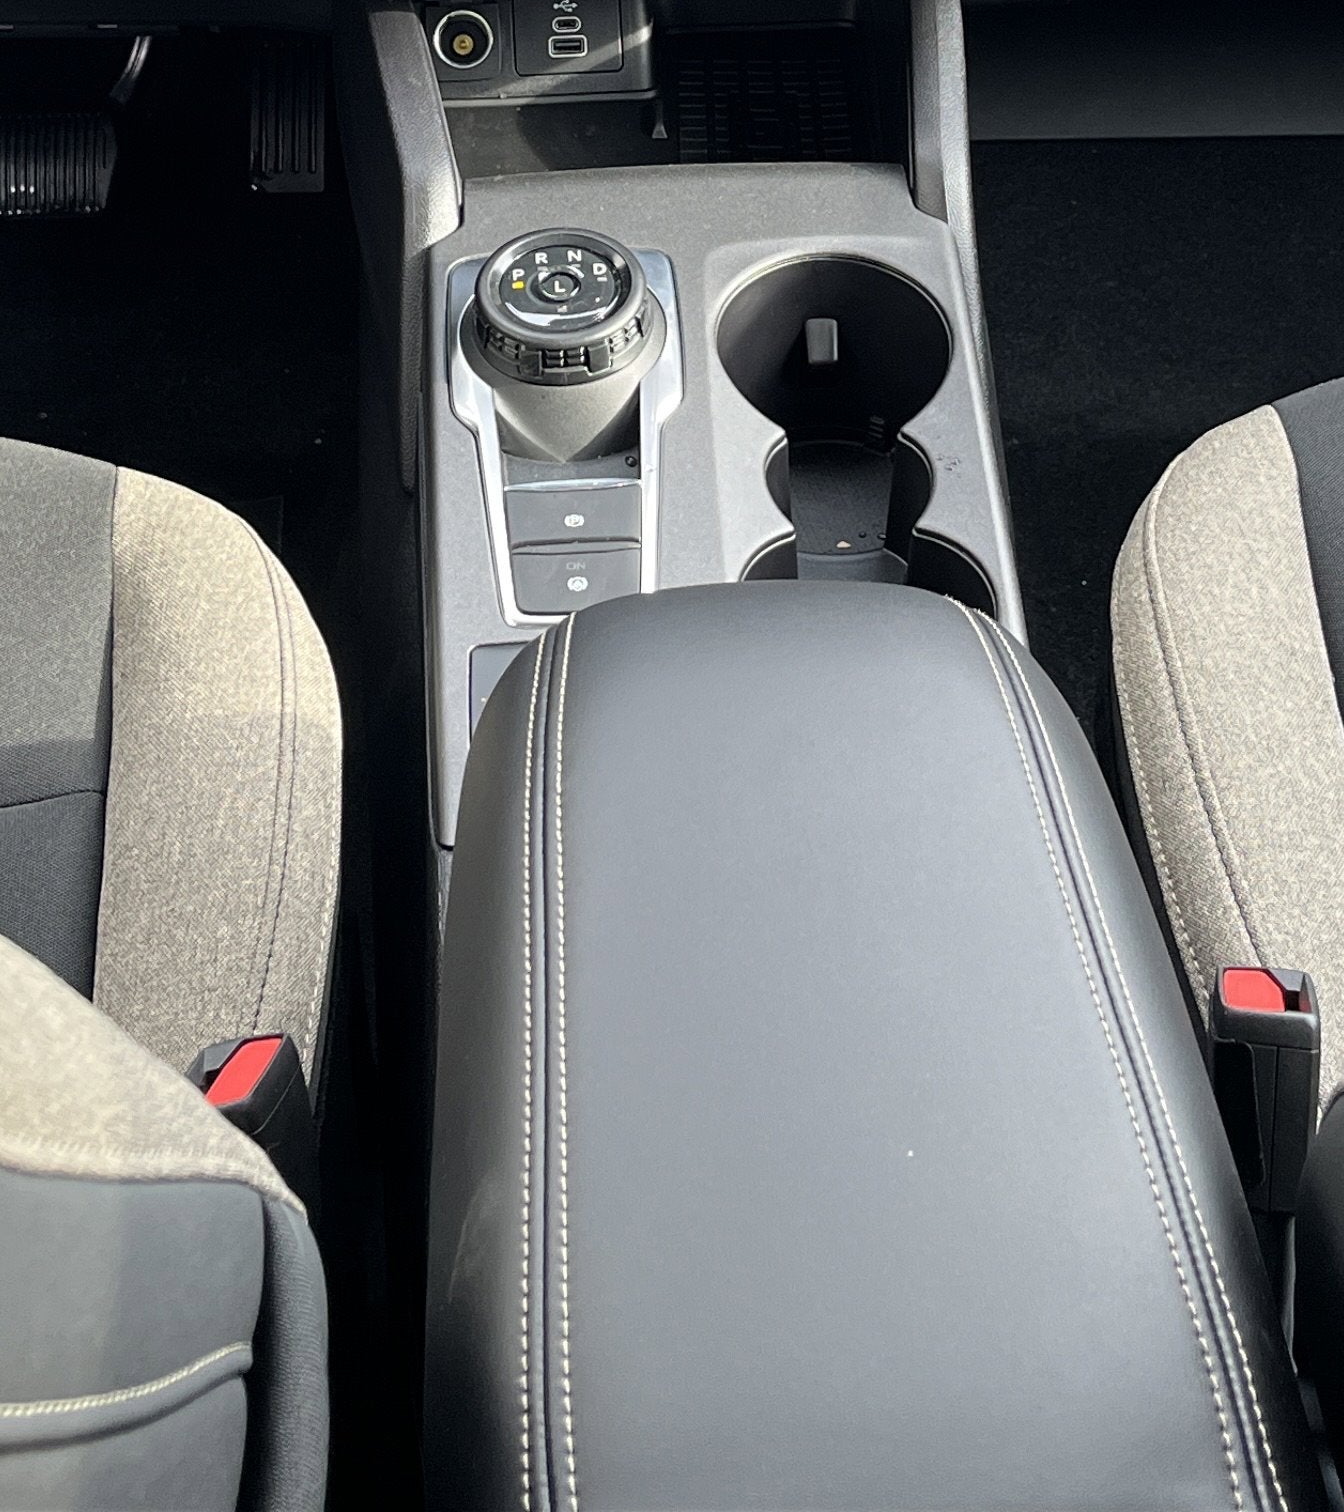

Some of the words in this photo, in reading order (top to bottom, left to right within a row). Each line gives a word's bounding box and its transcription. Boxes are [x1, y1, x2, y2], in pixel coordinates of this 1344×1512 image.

[534, 251, 549, 265] R
[567, 249, 582, 263] N
[512, 268, 525, 281] P
[592, 262, 608, 276] D
[554, 280, 566, 293] L
